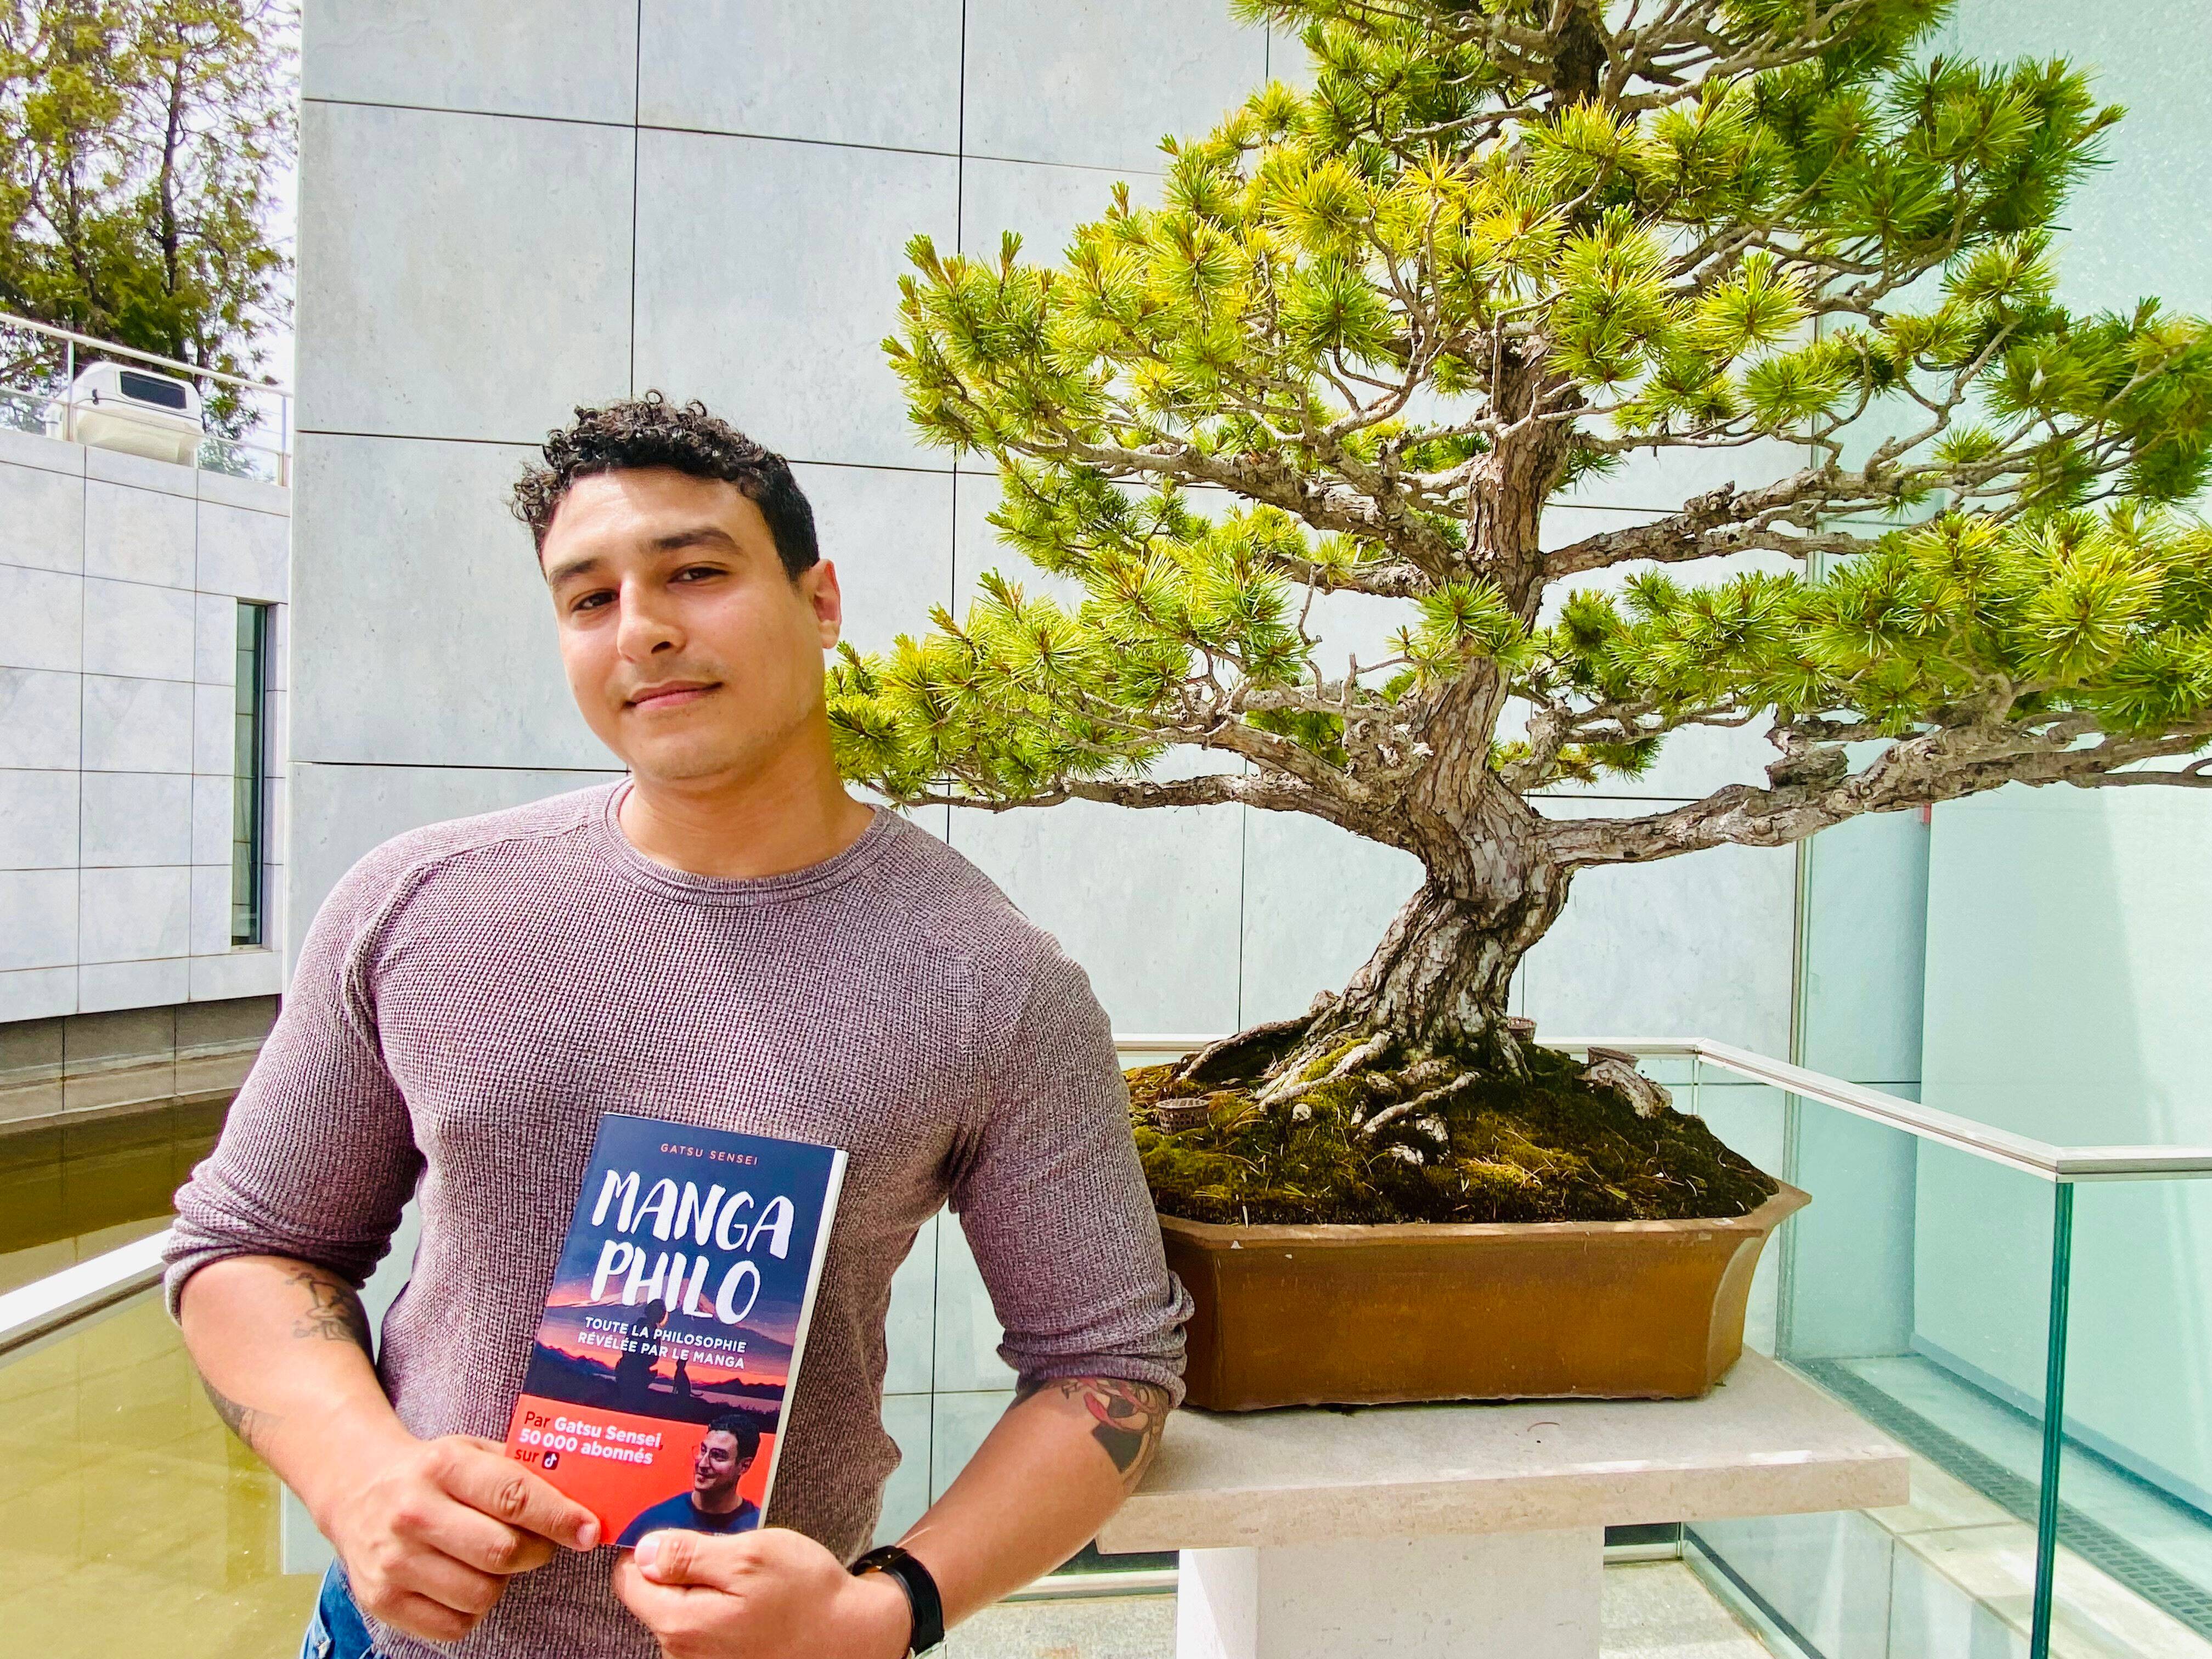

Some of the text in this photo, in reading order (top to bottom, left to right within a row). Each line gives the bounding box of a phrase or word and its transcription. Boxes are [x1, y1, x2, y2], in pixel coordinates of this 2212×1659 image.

[661, 1143, 758, 1165] GATSU SENSEI
[591, 1169, 794, 1260] MANGA
[590, 1239, 760, 1324] PHILO
[578, 1331, 744, 1369] RÉVÉLÉE PAR LE MANGA
[585, 1316, 747, 1353] TOUTE LA PHILOSOPHIE
[524, 1411, 663, 1451] Par Gatsu Sensei,
[514, 1448, 539, 1463] sur
[580, 1440, 653, 1465] abonnés
